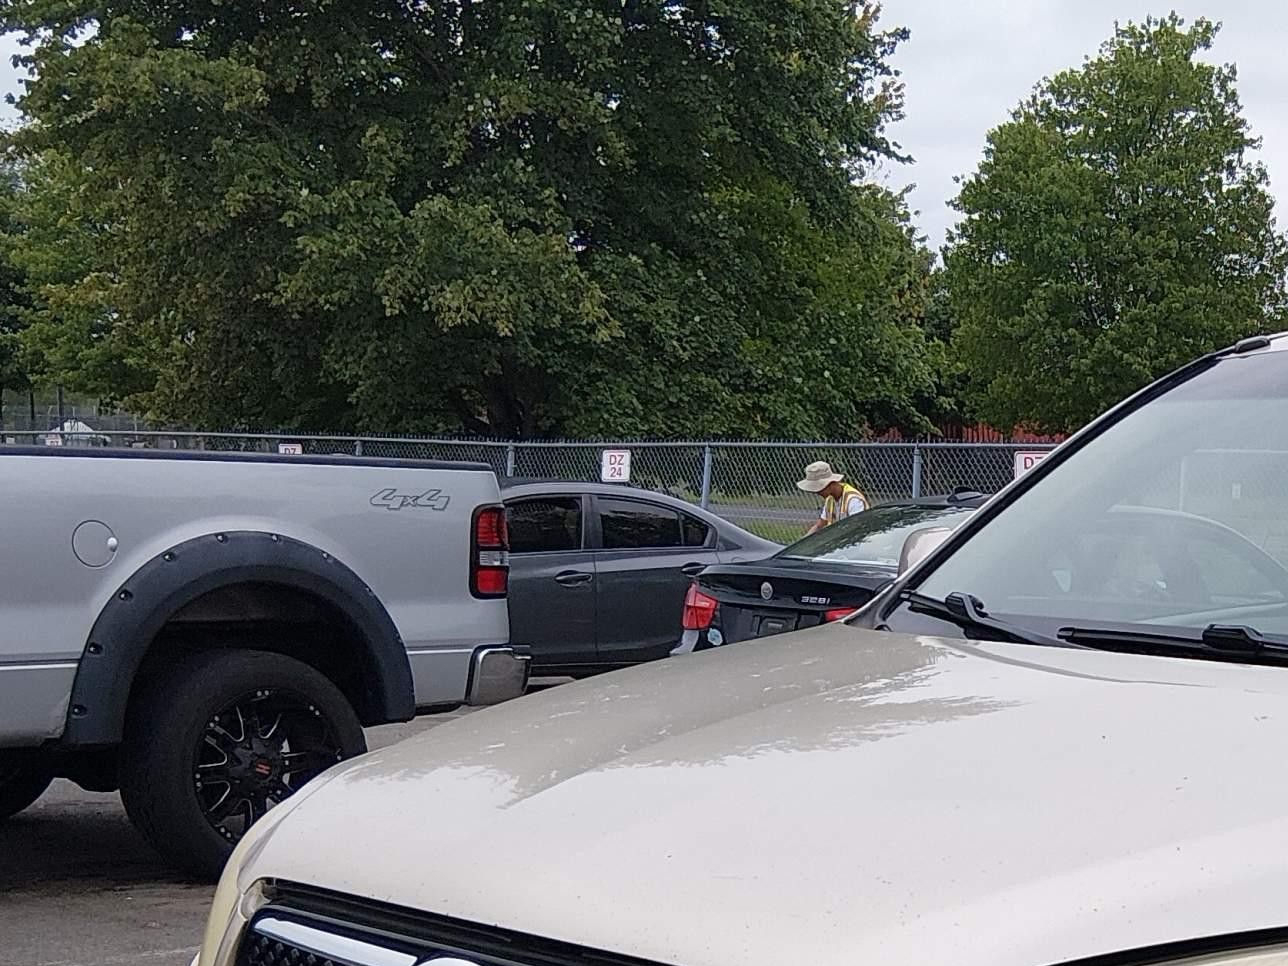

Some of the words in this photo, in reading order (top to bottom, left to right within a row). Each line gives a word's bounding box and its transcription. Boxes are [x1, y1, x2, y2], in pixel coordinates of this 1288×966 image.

[608, 454, 625, 466] DZ
[1023, 456, 1044, 470] D
[610, 466, 622, 478] 24
[369, 488, 451, 512] 4x4
